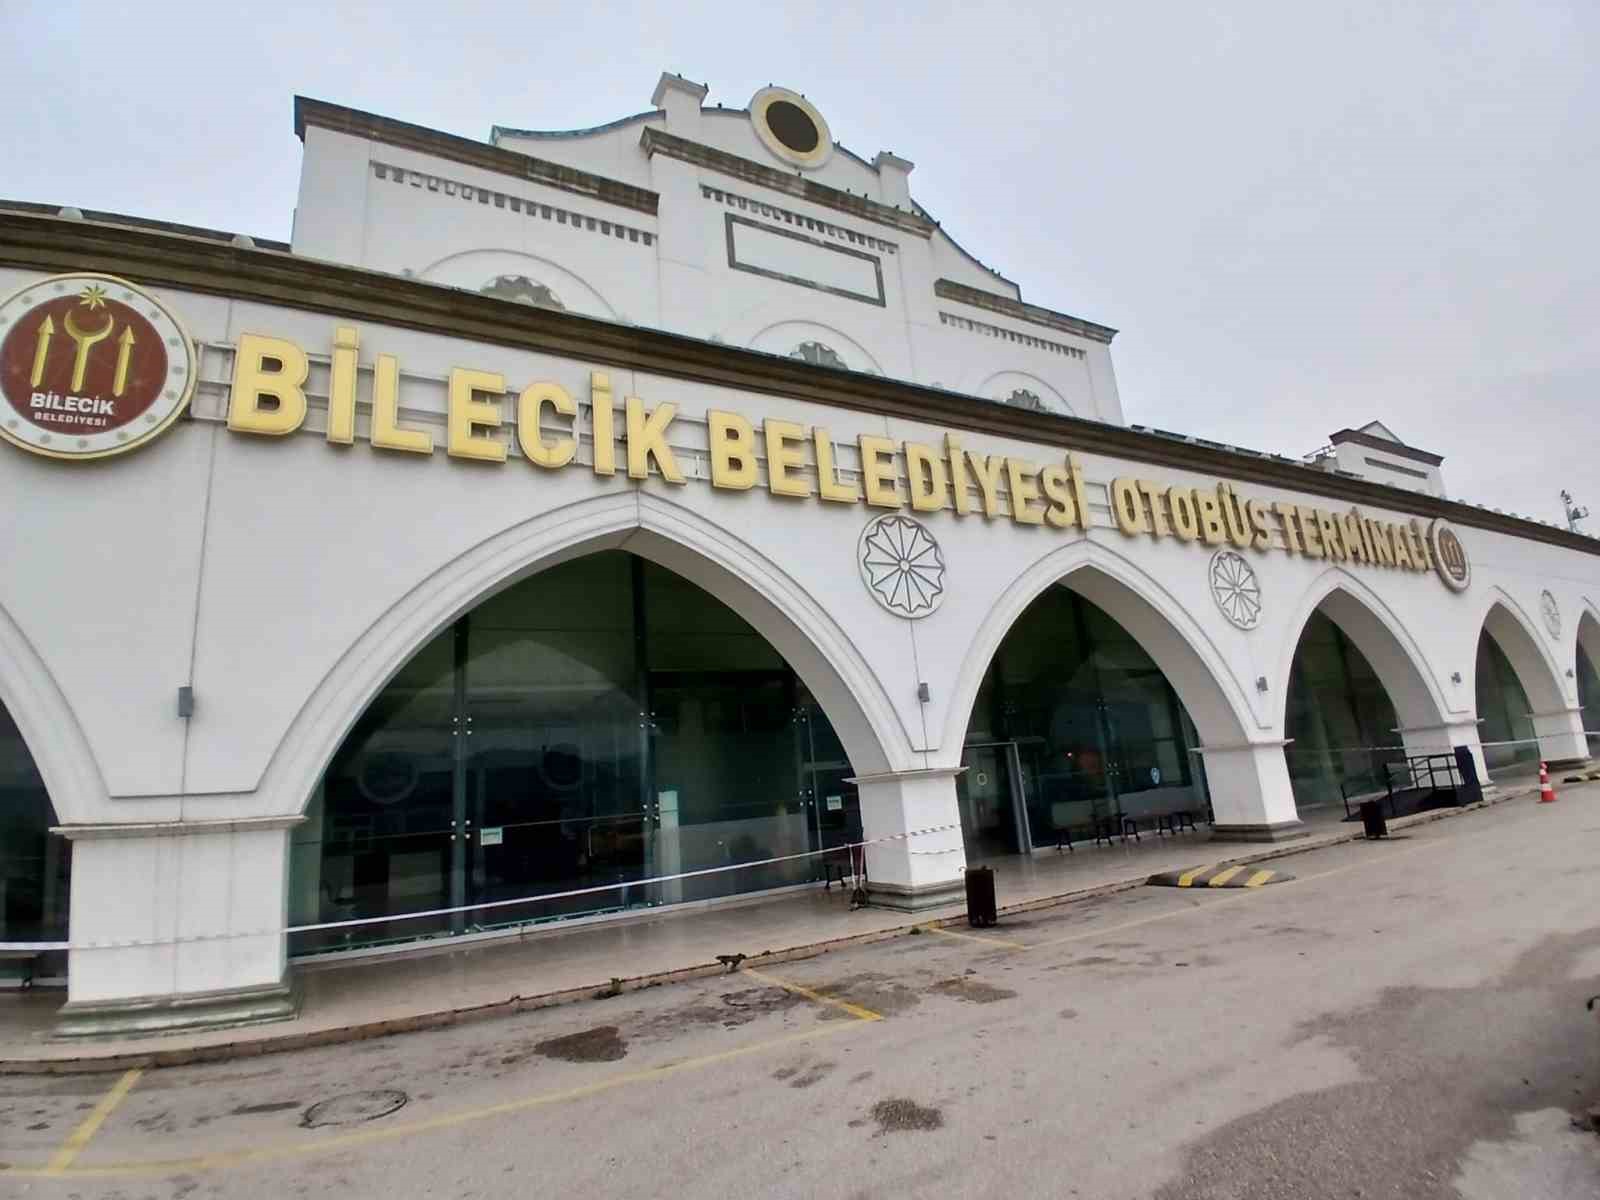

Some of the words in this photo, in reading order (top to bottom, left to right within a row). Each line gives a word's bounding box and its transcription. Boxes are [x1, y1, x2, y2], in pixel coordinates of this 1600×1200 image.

[30, 391, 115, 415] BİLECİK
[34, 411, 107, 426] BELEDİYESİ
[227, 327, 687, 485] BİLECİK
[706, 408, 1089, 529] BELEDİYESİ
[1110, 478, 1273, 551] OTOBÜS
